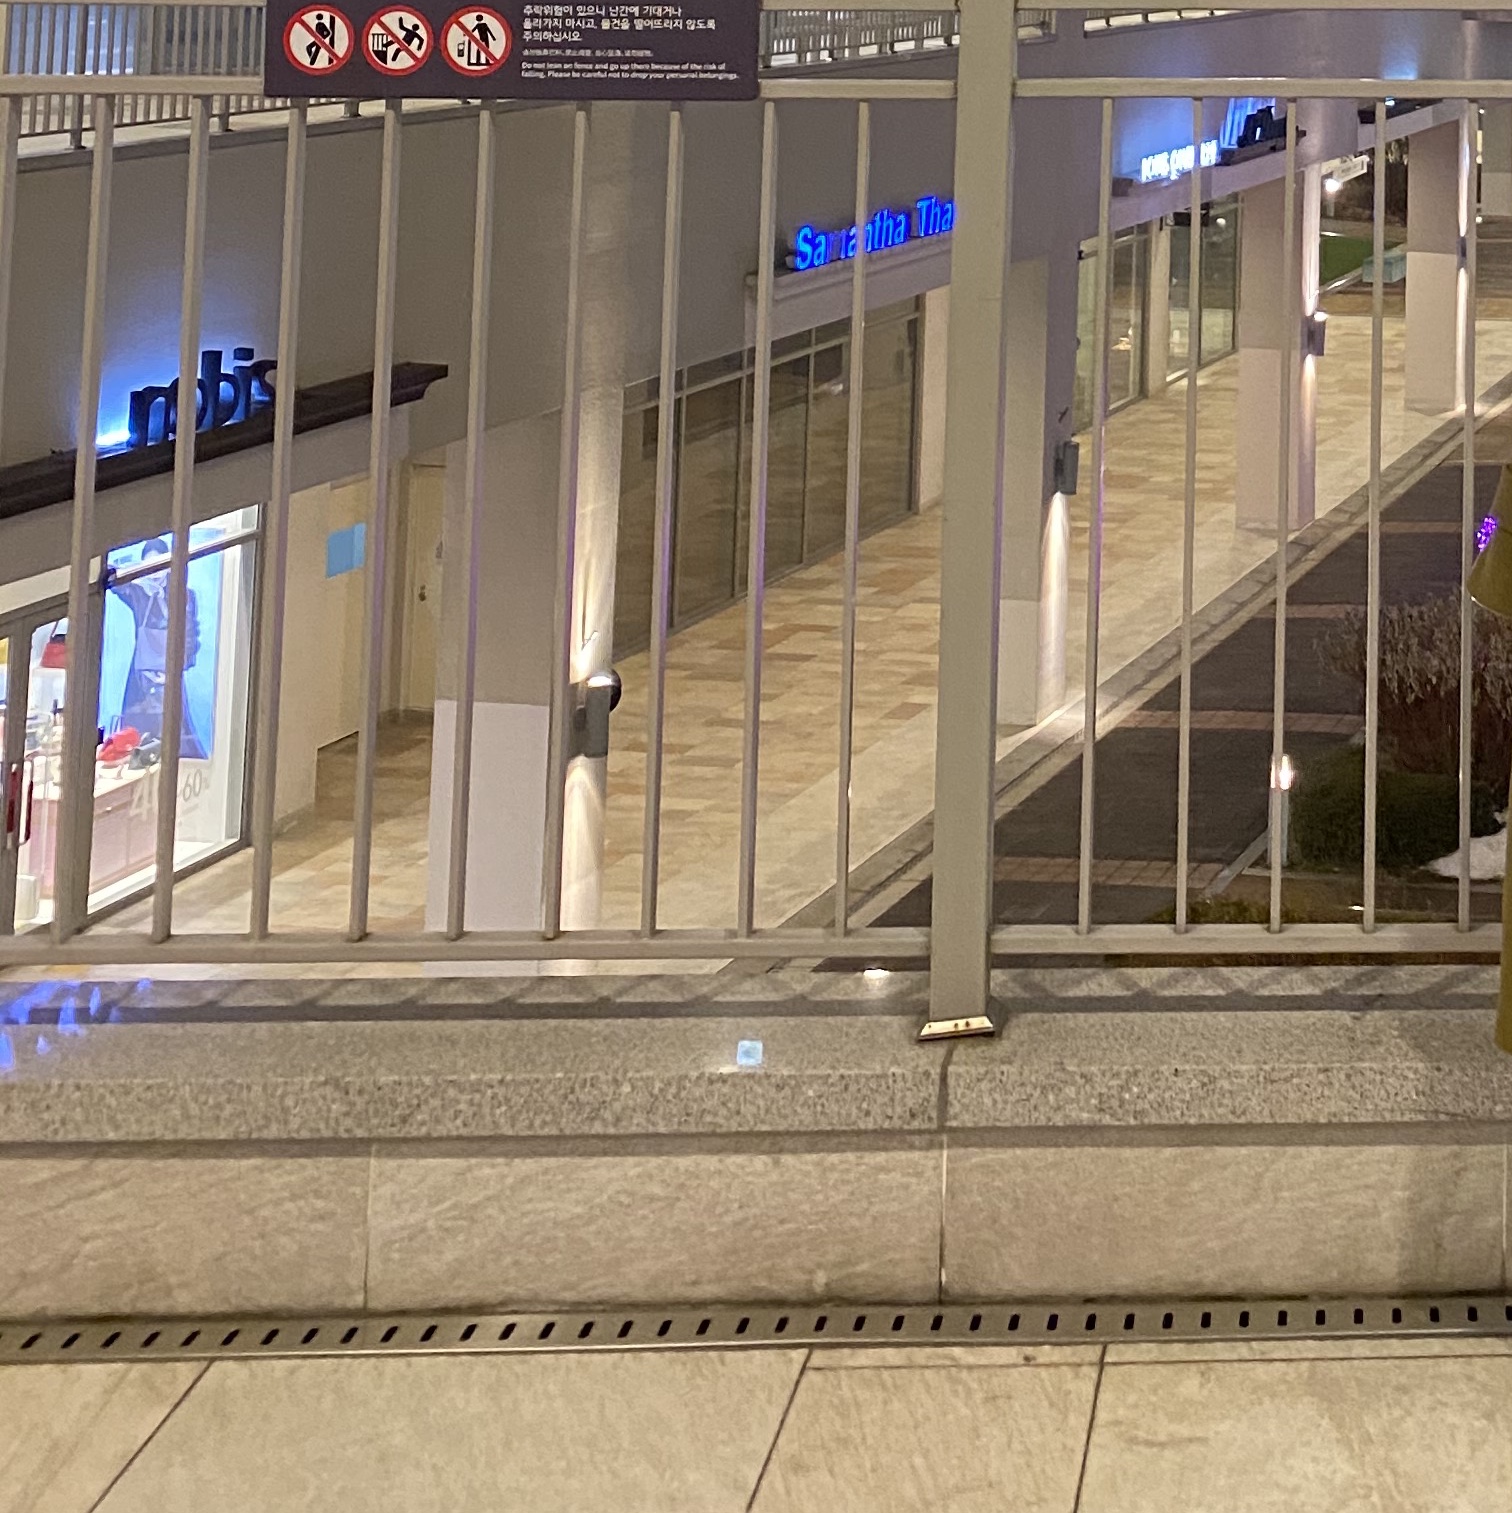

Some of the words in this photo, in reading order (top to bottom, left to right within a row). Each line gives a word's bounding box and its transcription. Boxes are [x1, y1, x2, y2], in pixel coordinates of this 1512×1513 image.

[524, 5, 573, 17] 추락위험이
[576, 5, 606, 17] 있으니
[608, 5, 640, 18] 난간에
[642, 5, 682, 18] 기대거나
[522, 61, 532, 69] Do
[594, 62, 609, 70] and
[609, 62, 619, 71] go
